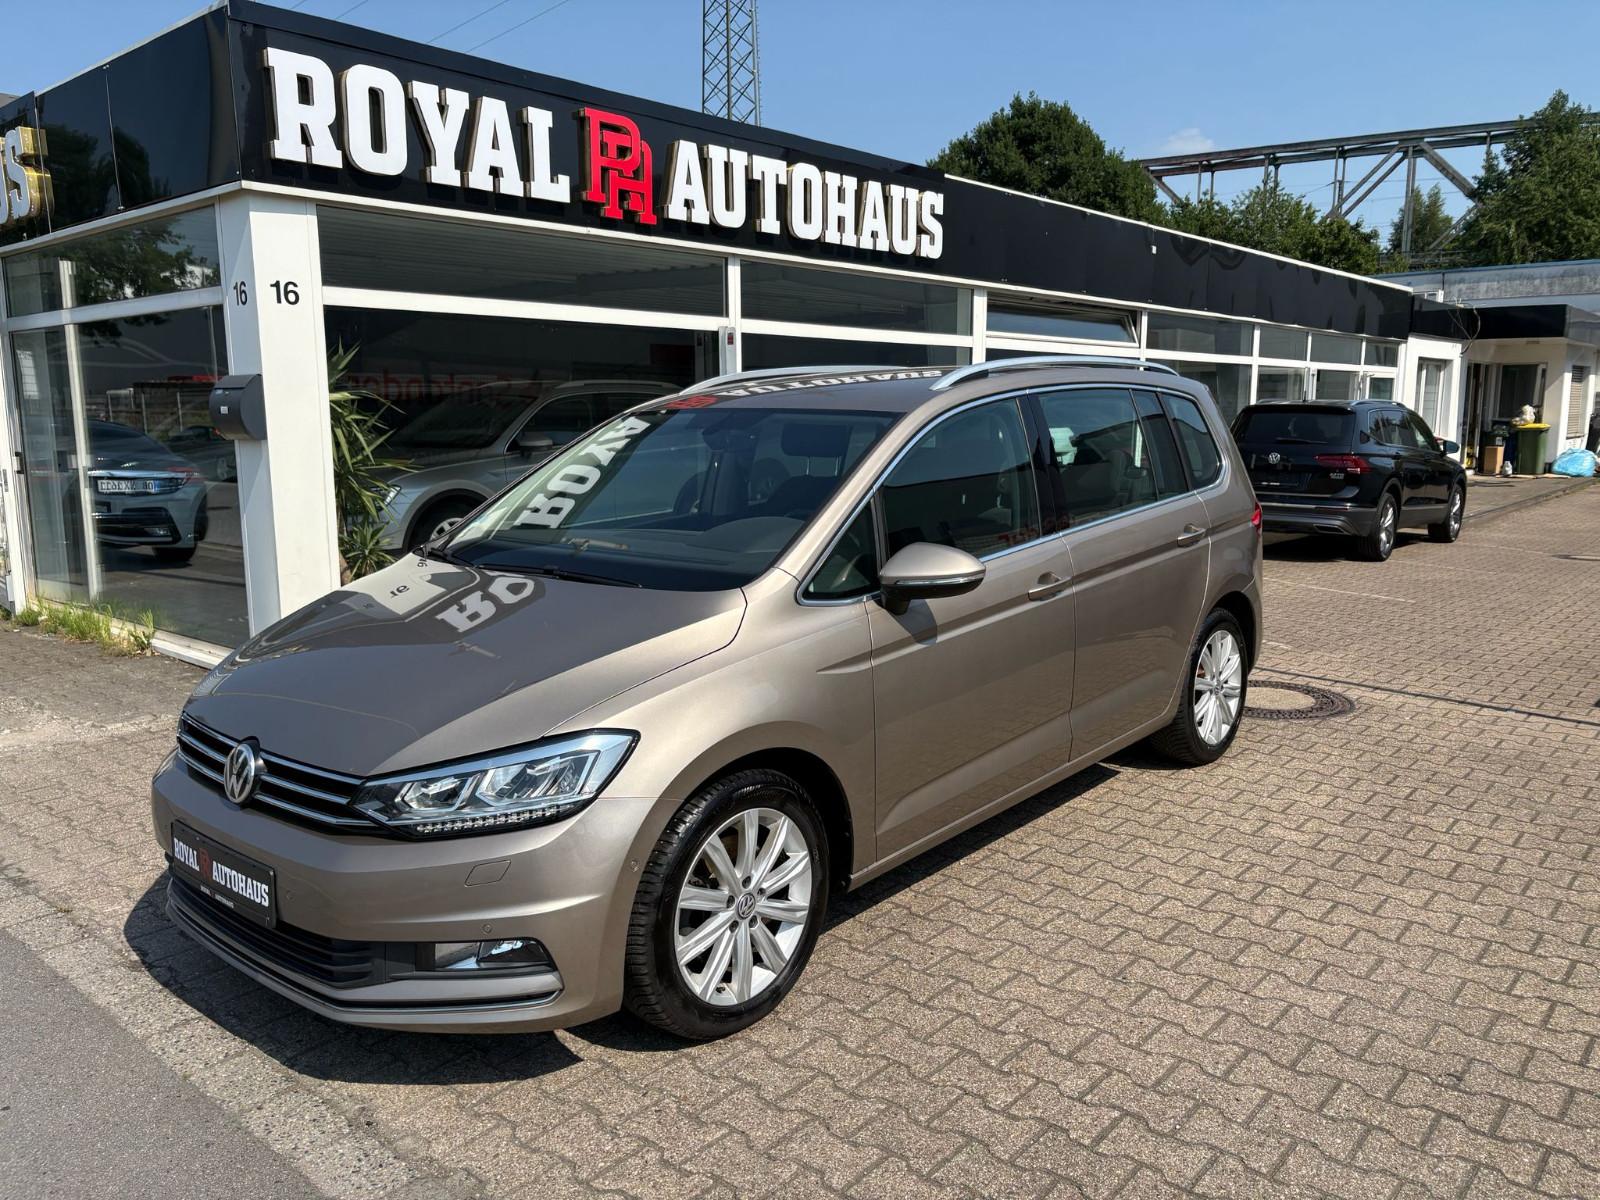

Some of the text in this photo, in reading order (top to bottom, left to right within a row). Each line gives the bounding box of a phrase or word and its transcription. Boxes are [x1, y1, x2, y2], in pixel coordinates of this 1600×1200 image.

[265, 47, 570, 204] ROYAL
[666, 140, 944, 260] AUTOHAUS
[233, 281, 248, 306] 16
[270, 280, 300, 306] 16
[174, 837, 200, 872] ROYAL
[212, 860, 269, 908] AUTOHAUS
